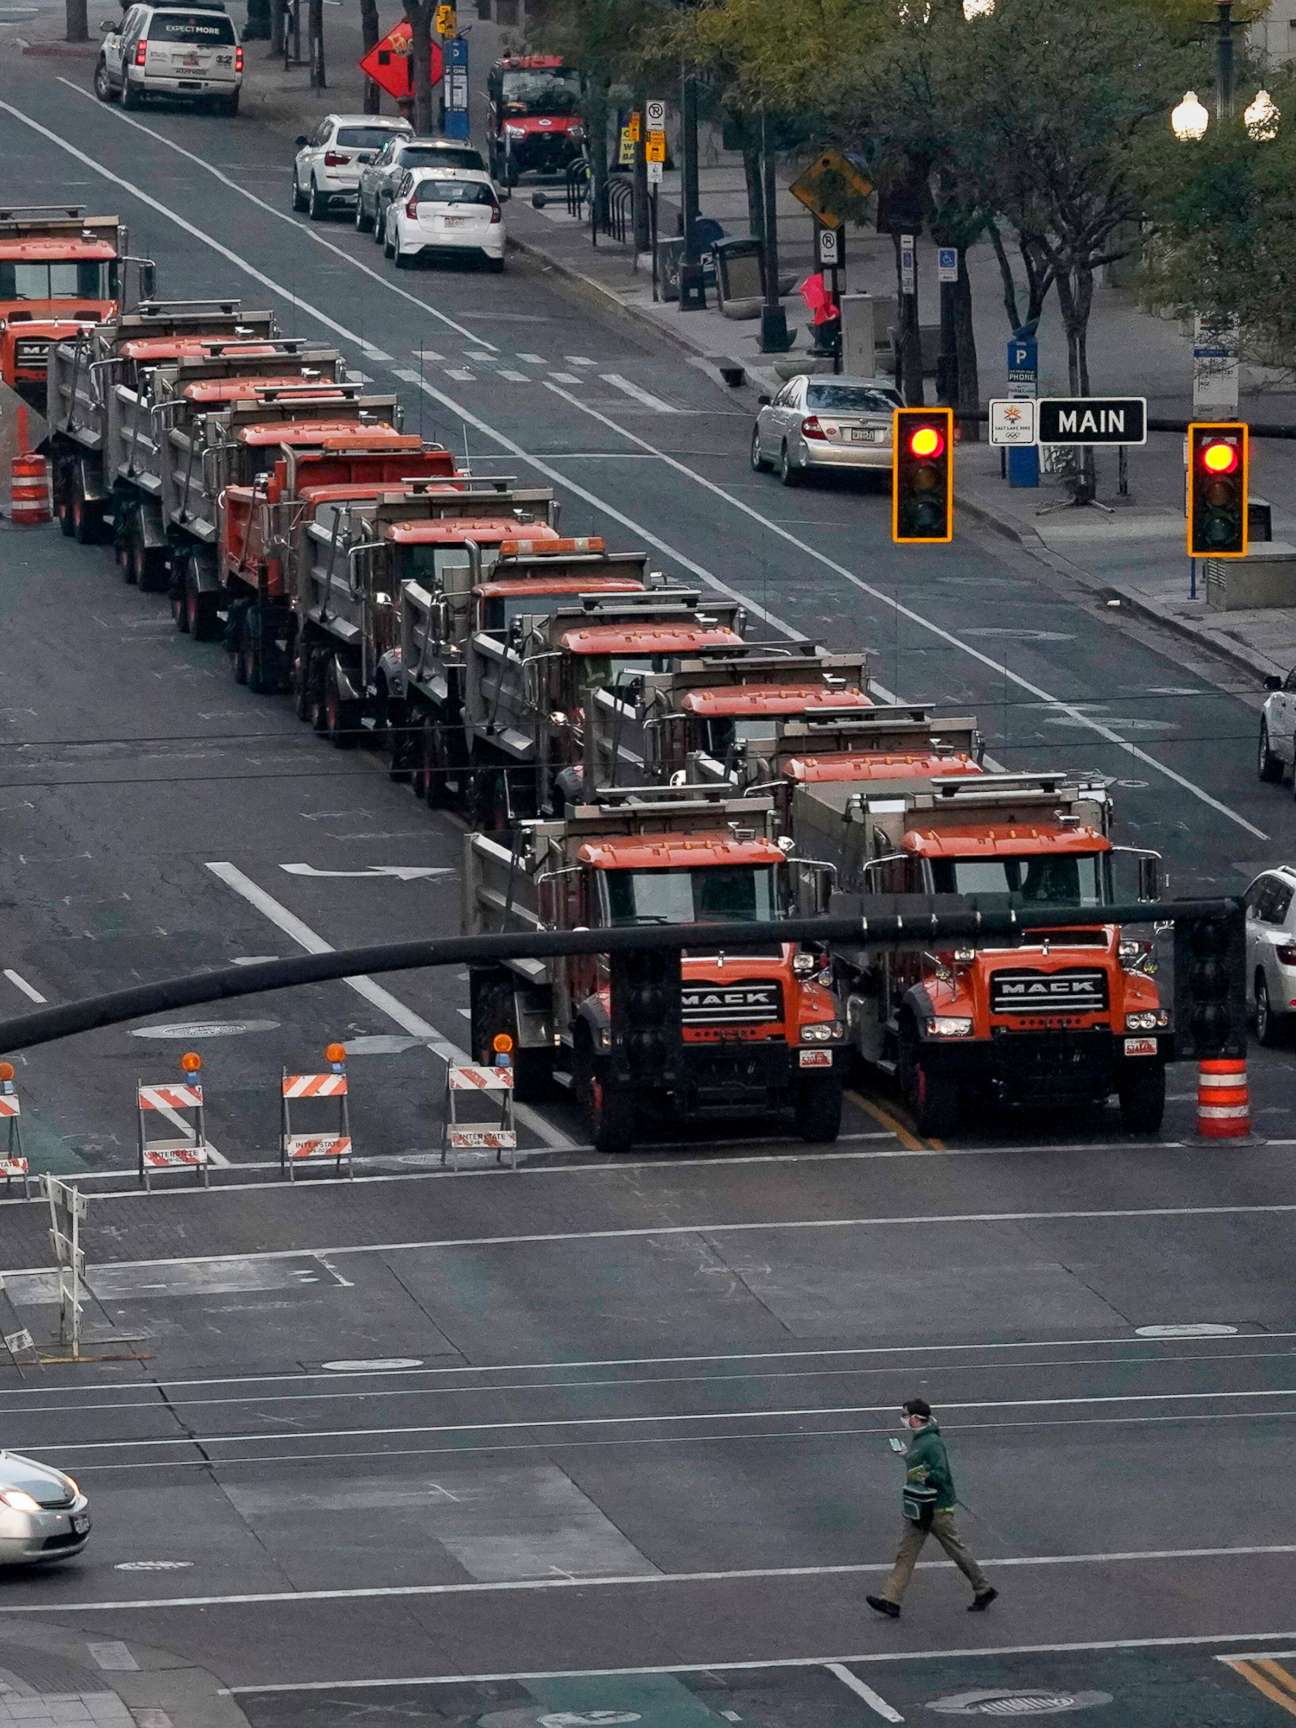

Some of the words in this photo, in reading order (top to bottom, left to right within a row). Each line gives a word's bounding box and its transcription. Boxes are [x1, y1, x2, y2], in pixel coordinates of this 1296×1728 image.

[166, 25, 195, 33] EXPECT
[196, 26, 220, 34] MORE
[1016, 349, 1027, 364] P
[1058, 410, 1125, 433] MAIN
[1002, 981, 1095, 994] MACK
[296, 1141, 342, 1149] INTERSTATE
